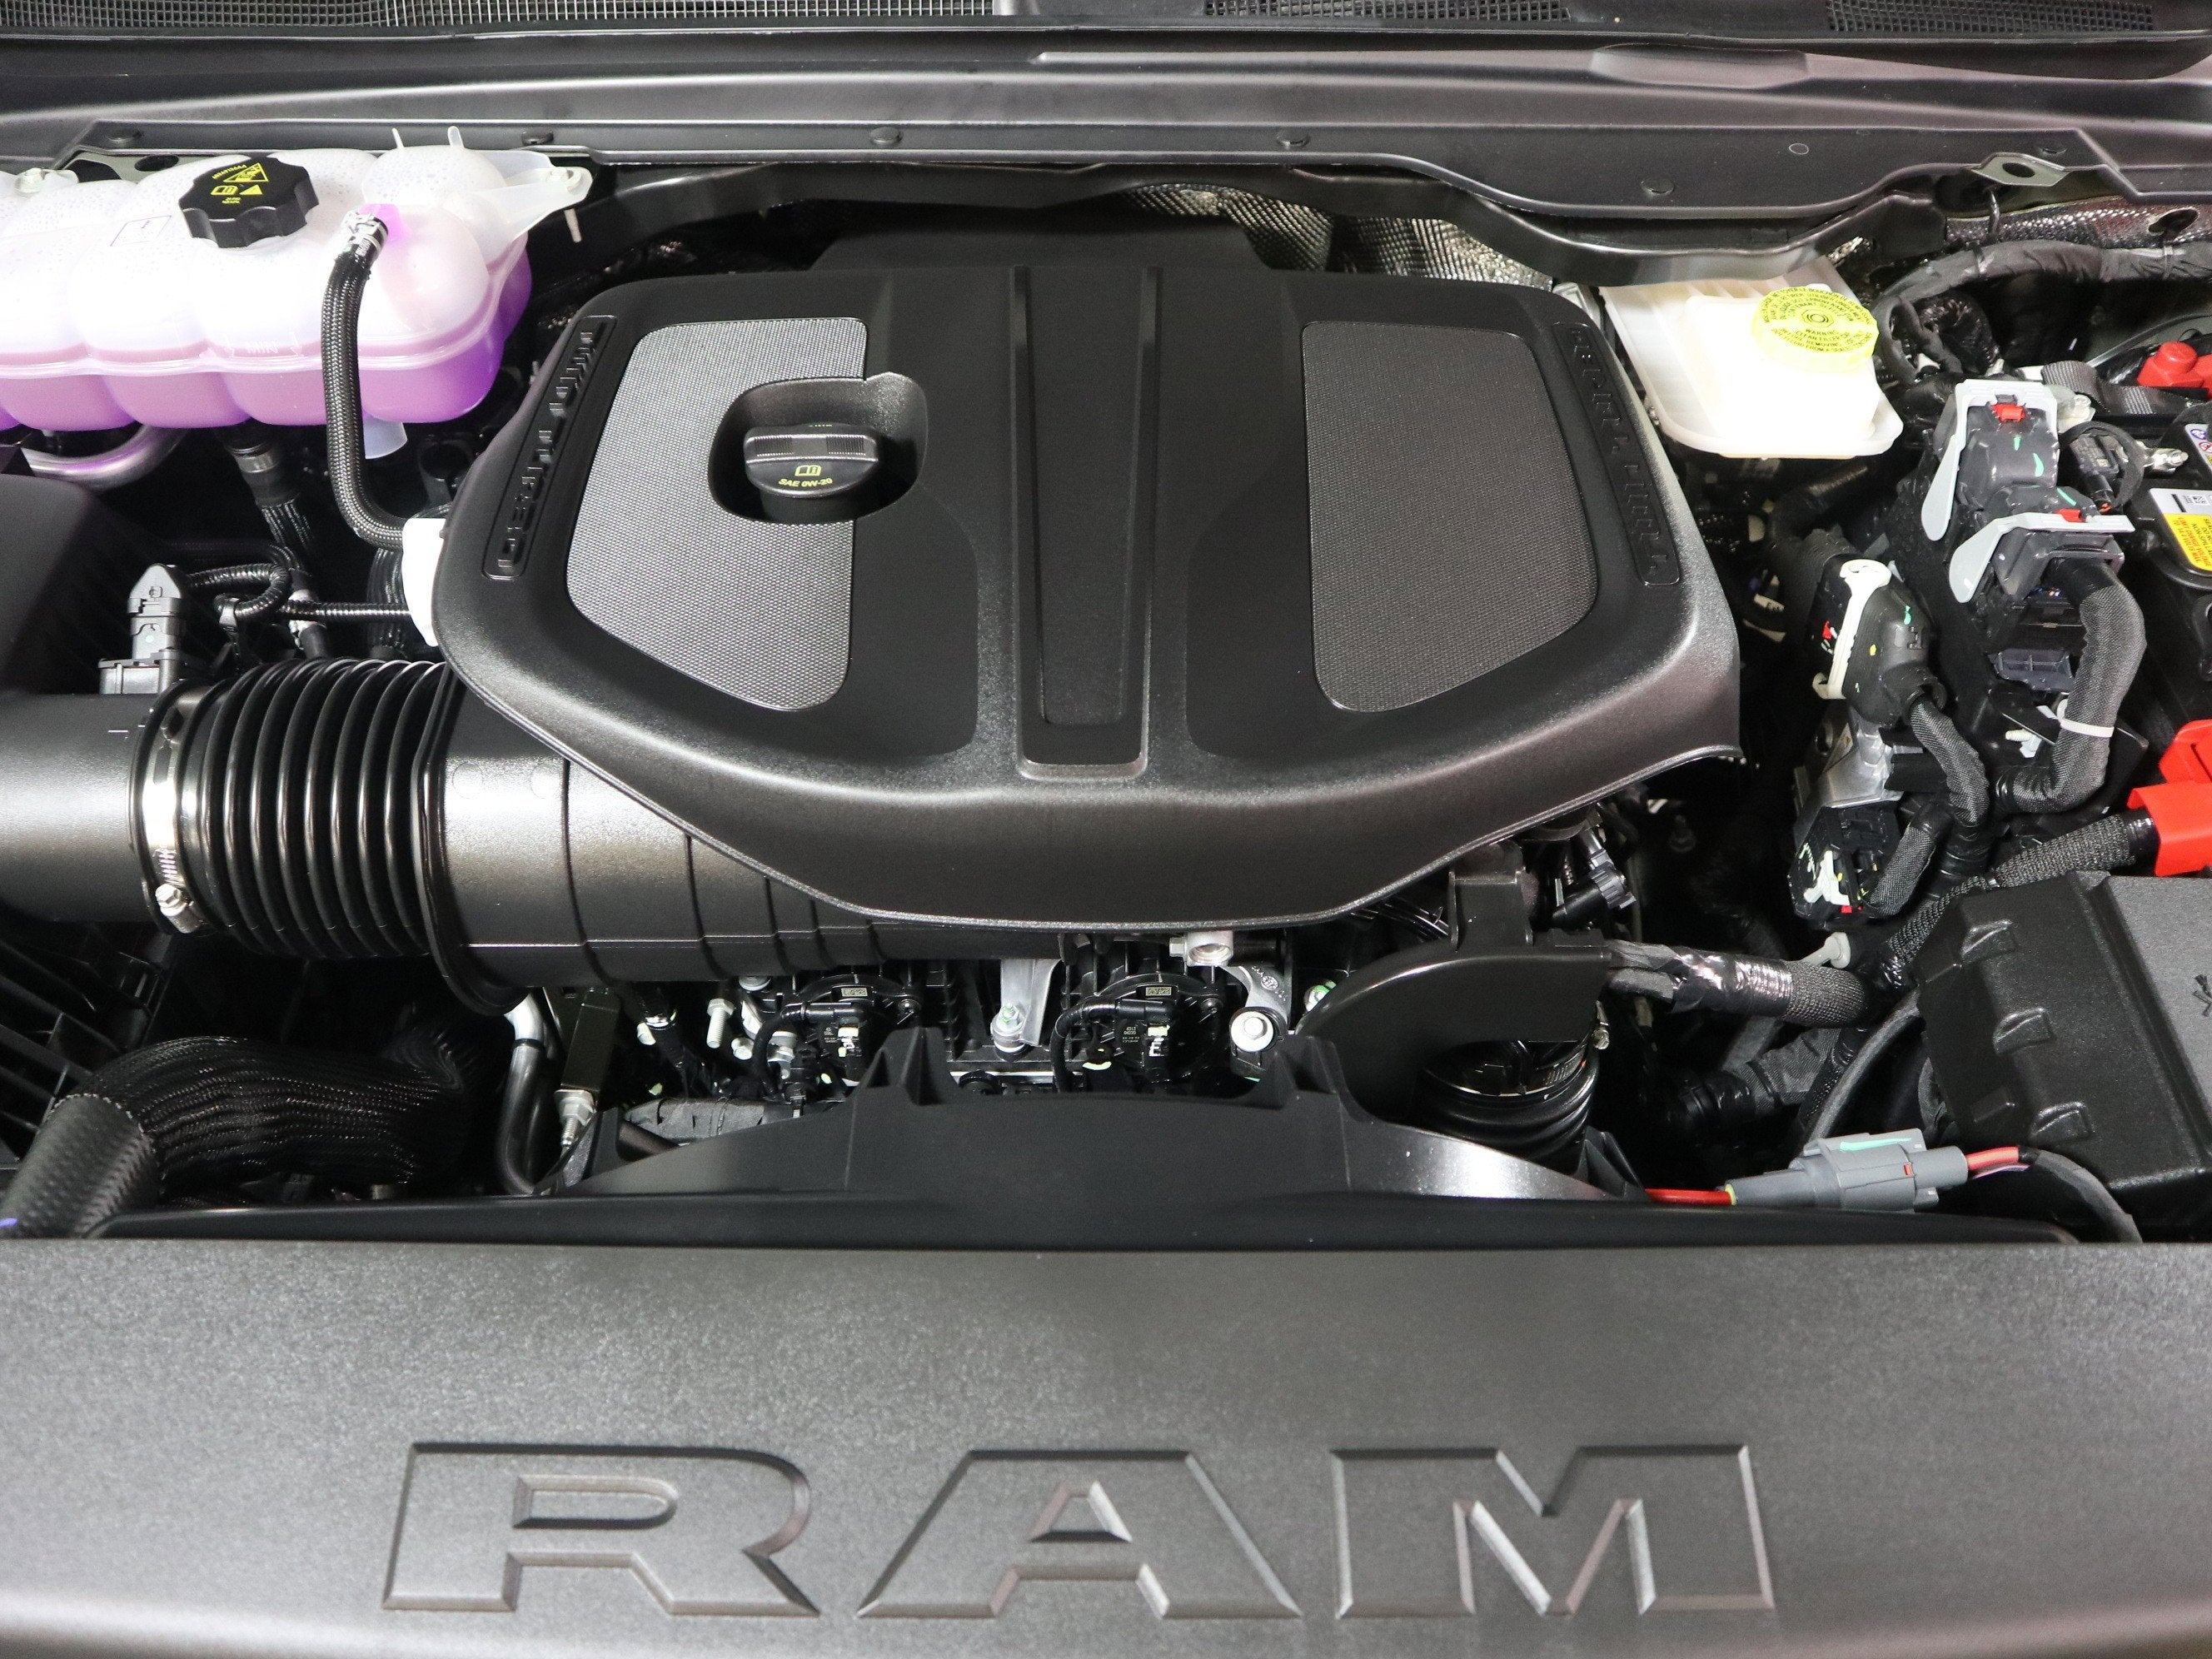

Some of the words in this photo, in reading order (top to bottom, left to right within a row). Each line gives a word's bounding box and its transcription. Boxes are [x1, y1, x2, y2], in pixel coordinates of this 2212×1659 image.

[778, 478, 800, 487] SAE
[801, 477, 833, 487] 0W-20
[382, 1442, 1775, 1619] RAM
